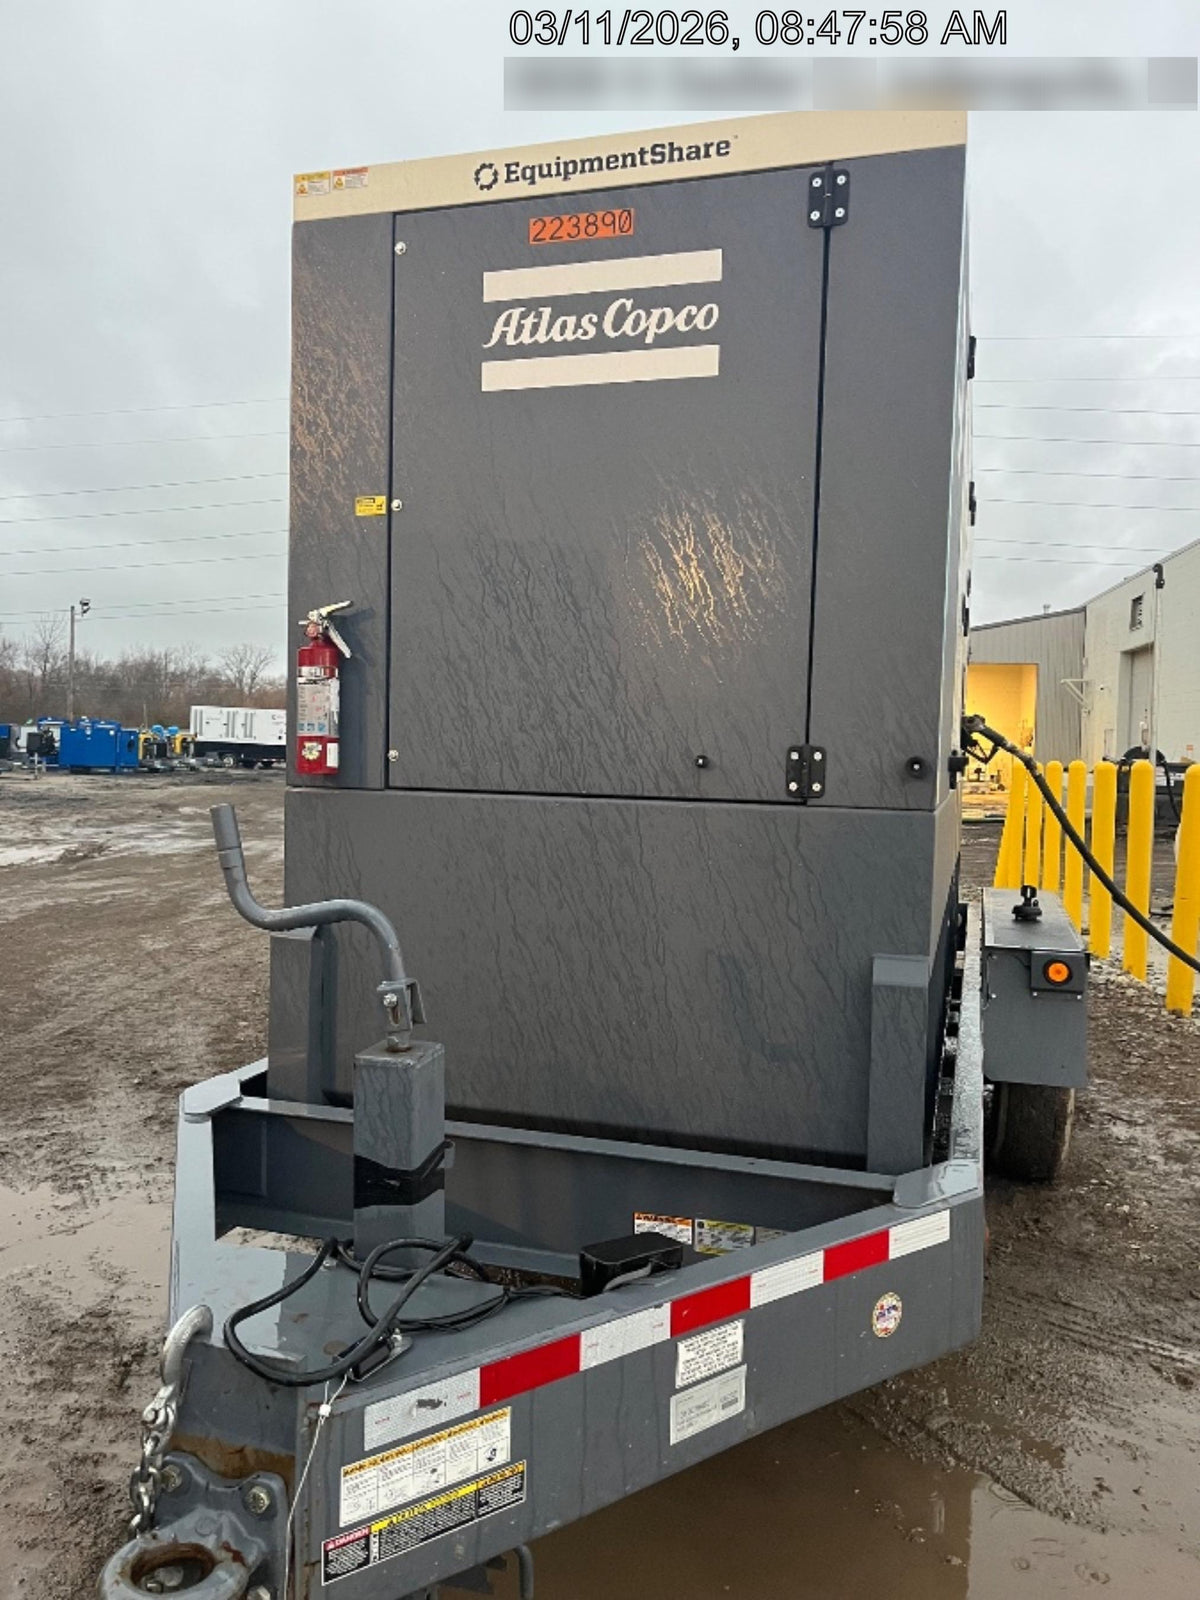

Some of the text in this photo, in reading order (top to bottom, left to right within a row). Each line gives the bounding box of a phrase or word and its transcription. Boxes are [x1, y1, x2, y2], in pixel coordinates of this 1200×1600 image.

[504, 139, 732, 185] EquipmentShare
[531, 209, 633, 243] 223890
[482, 298, 720, 348] Atlas Copco
